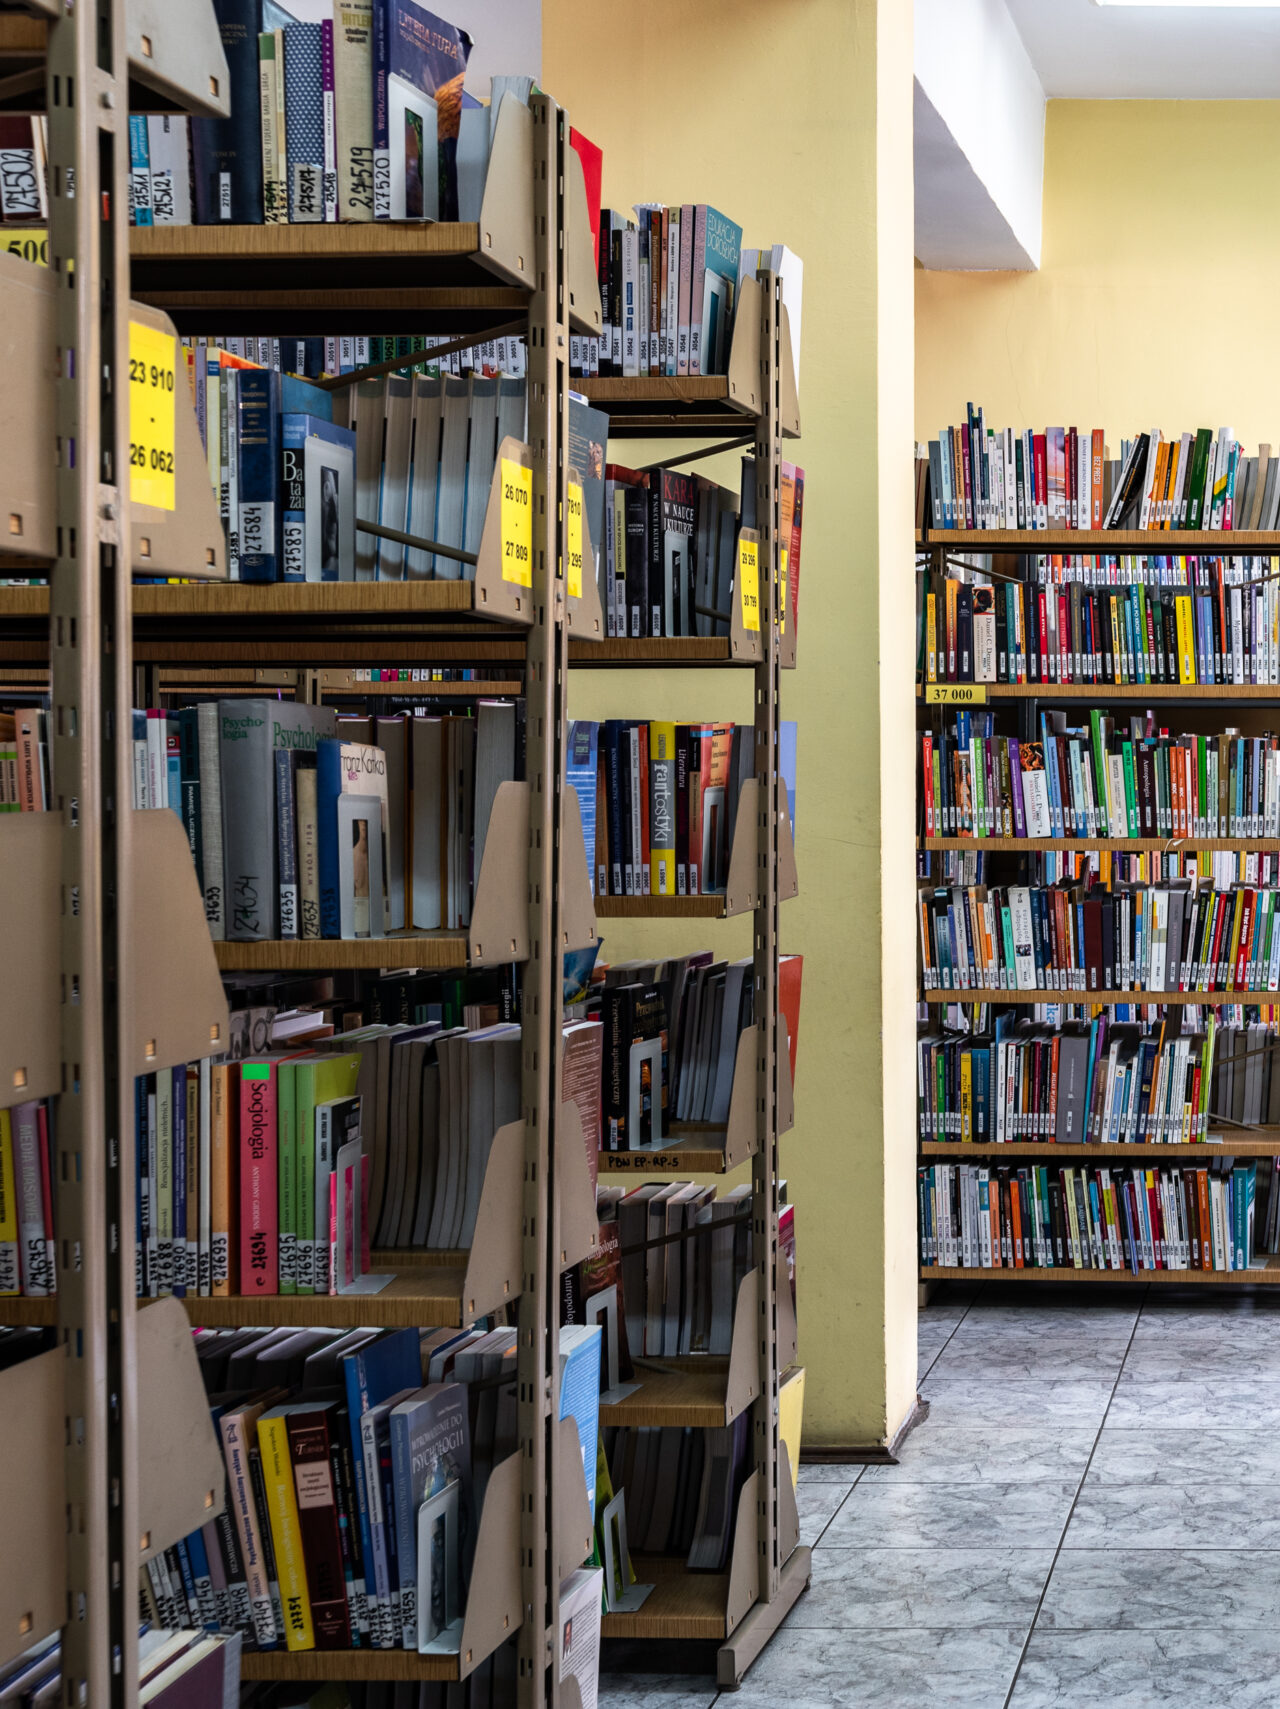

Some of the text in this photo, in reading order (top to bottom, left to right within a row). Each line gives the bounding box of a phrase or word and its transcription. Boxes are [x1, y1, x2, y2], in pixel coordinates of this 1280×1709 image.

[341, 13, 372, 26] HITLER
[1, 151, 39, 209] 27502
[350, 147, 373, 209] 27519
[376, 157, 390, 216] 27520
[709, 214, 735, 243] EDUKACJA
[130, 359, 173, 392] 23 910
[130, 444, 174, 473] 26 062
[506, 484, 527, 505] 26 070
[664, 475, 694, 506] KARA
[664, 502, 694, 521] W NAUCE
[664, 518, 693, 536] I KULTURZE
[245, 507, 261, 552] 27584
[285, 527, 301, 574] 27585
[506, 542, 527, 561] 27 809
[742, 553, 747, 564] 29
[744, 594, 749, 606] 30
[934, 690, 972, 699] 37 000
[223, 717, 264, 729] Psycho-
[223, 729, 248, 741] logia
[362, 749, 384, 775] Kafka
[654, 763, 671, 841] fantastyki
[281, 891, 293, 930] 27635
[248, 1083, 268, 1159] Socjologia
[20, 1125, 38, 1220] MEDIA MASOWE
[608, 1156, 630, 1167] PBN
[159, 1243, 172, 1289] 27688
[214, 1238, 226, 1277] 27693
[280, 1235, 296, 1279] 27695
[299, 1245, 311, 1286] 27696
[412, 1430, 464, 1474] PSYCHOLOGII
